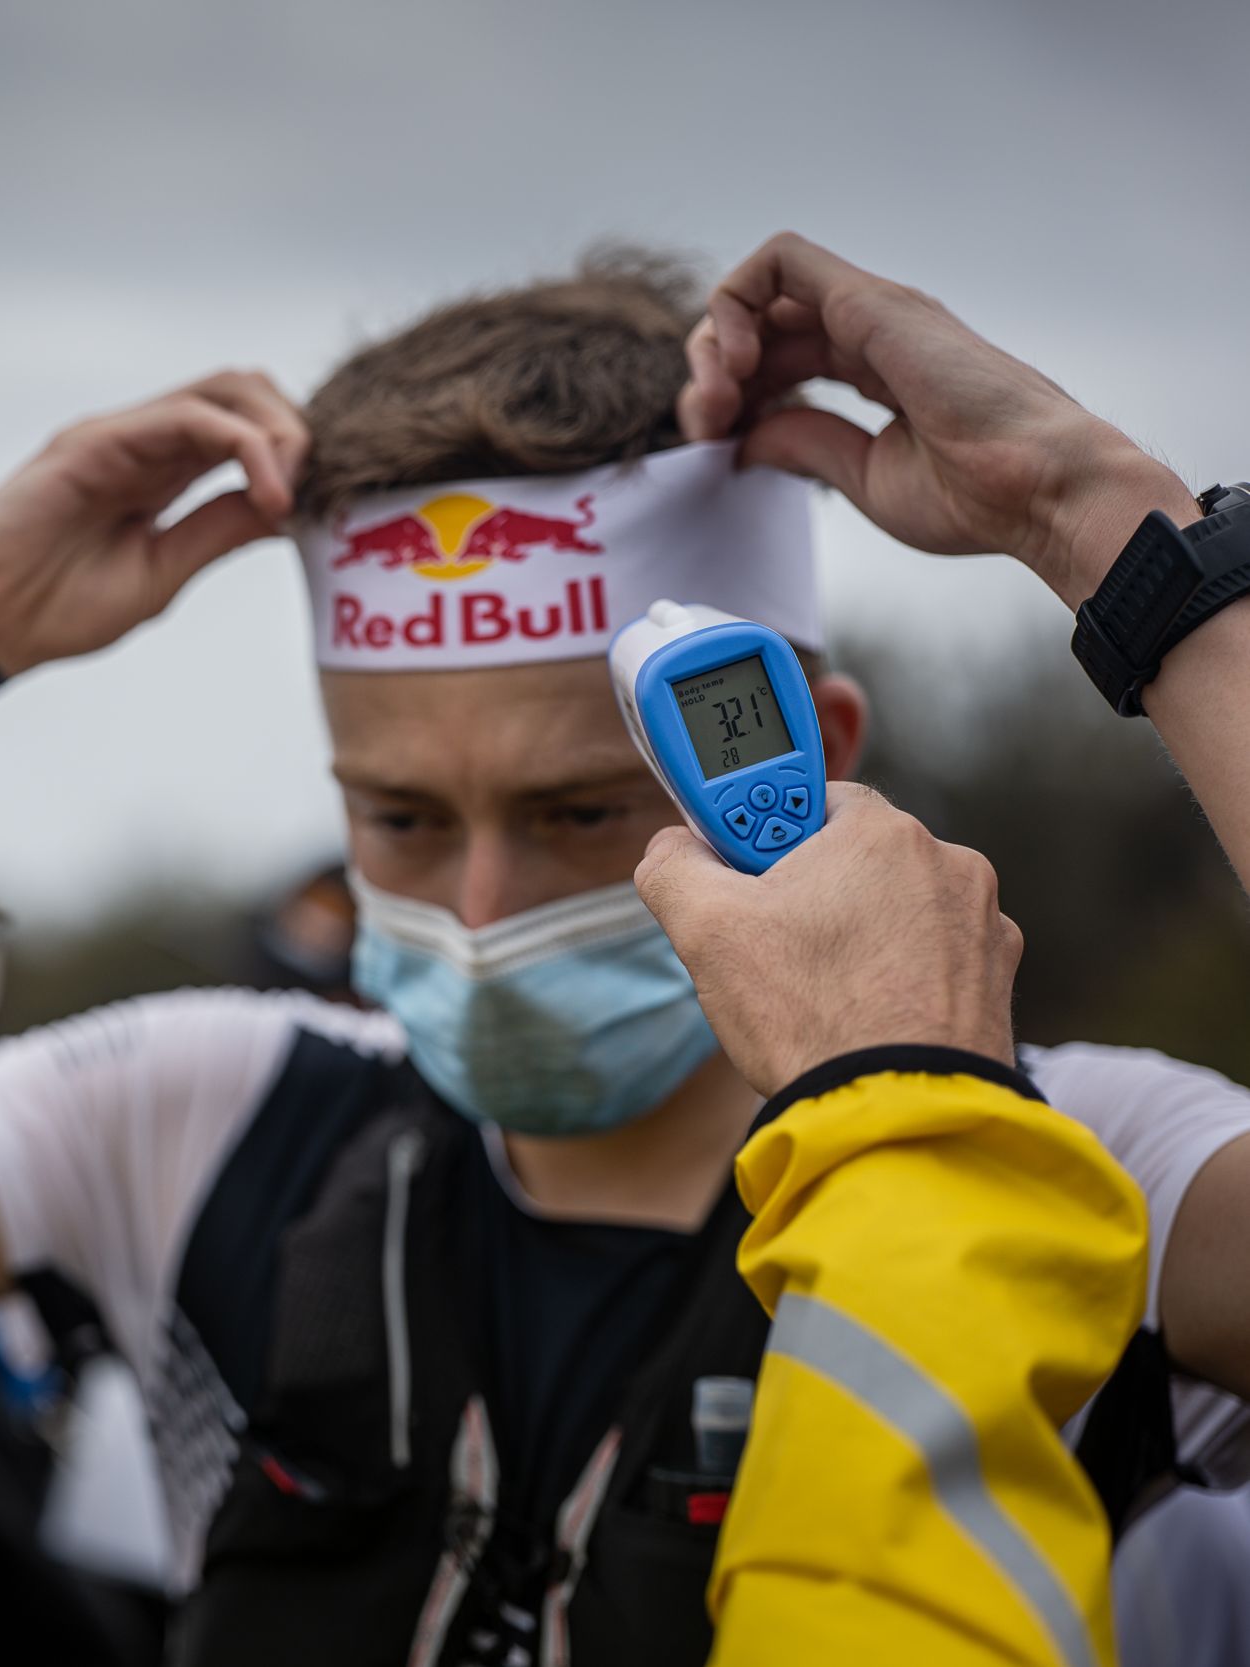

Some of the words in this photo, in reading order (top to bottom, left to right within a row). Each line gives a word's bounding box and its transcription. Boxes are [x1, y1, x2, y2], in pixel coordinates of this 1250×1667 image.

[332, 590, 444, 650] Red
[460, 575, 609, 647] Bull
[677, 685, 700, 698] Body
[702, 678, 724, 690] temp
[681, 694, 706, 707] HOLD
[720, 747, 740, 768] 28
